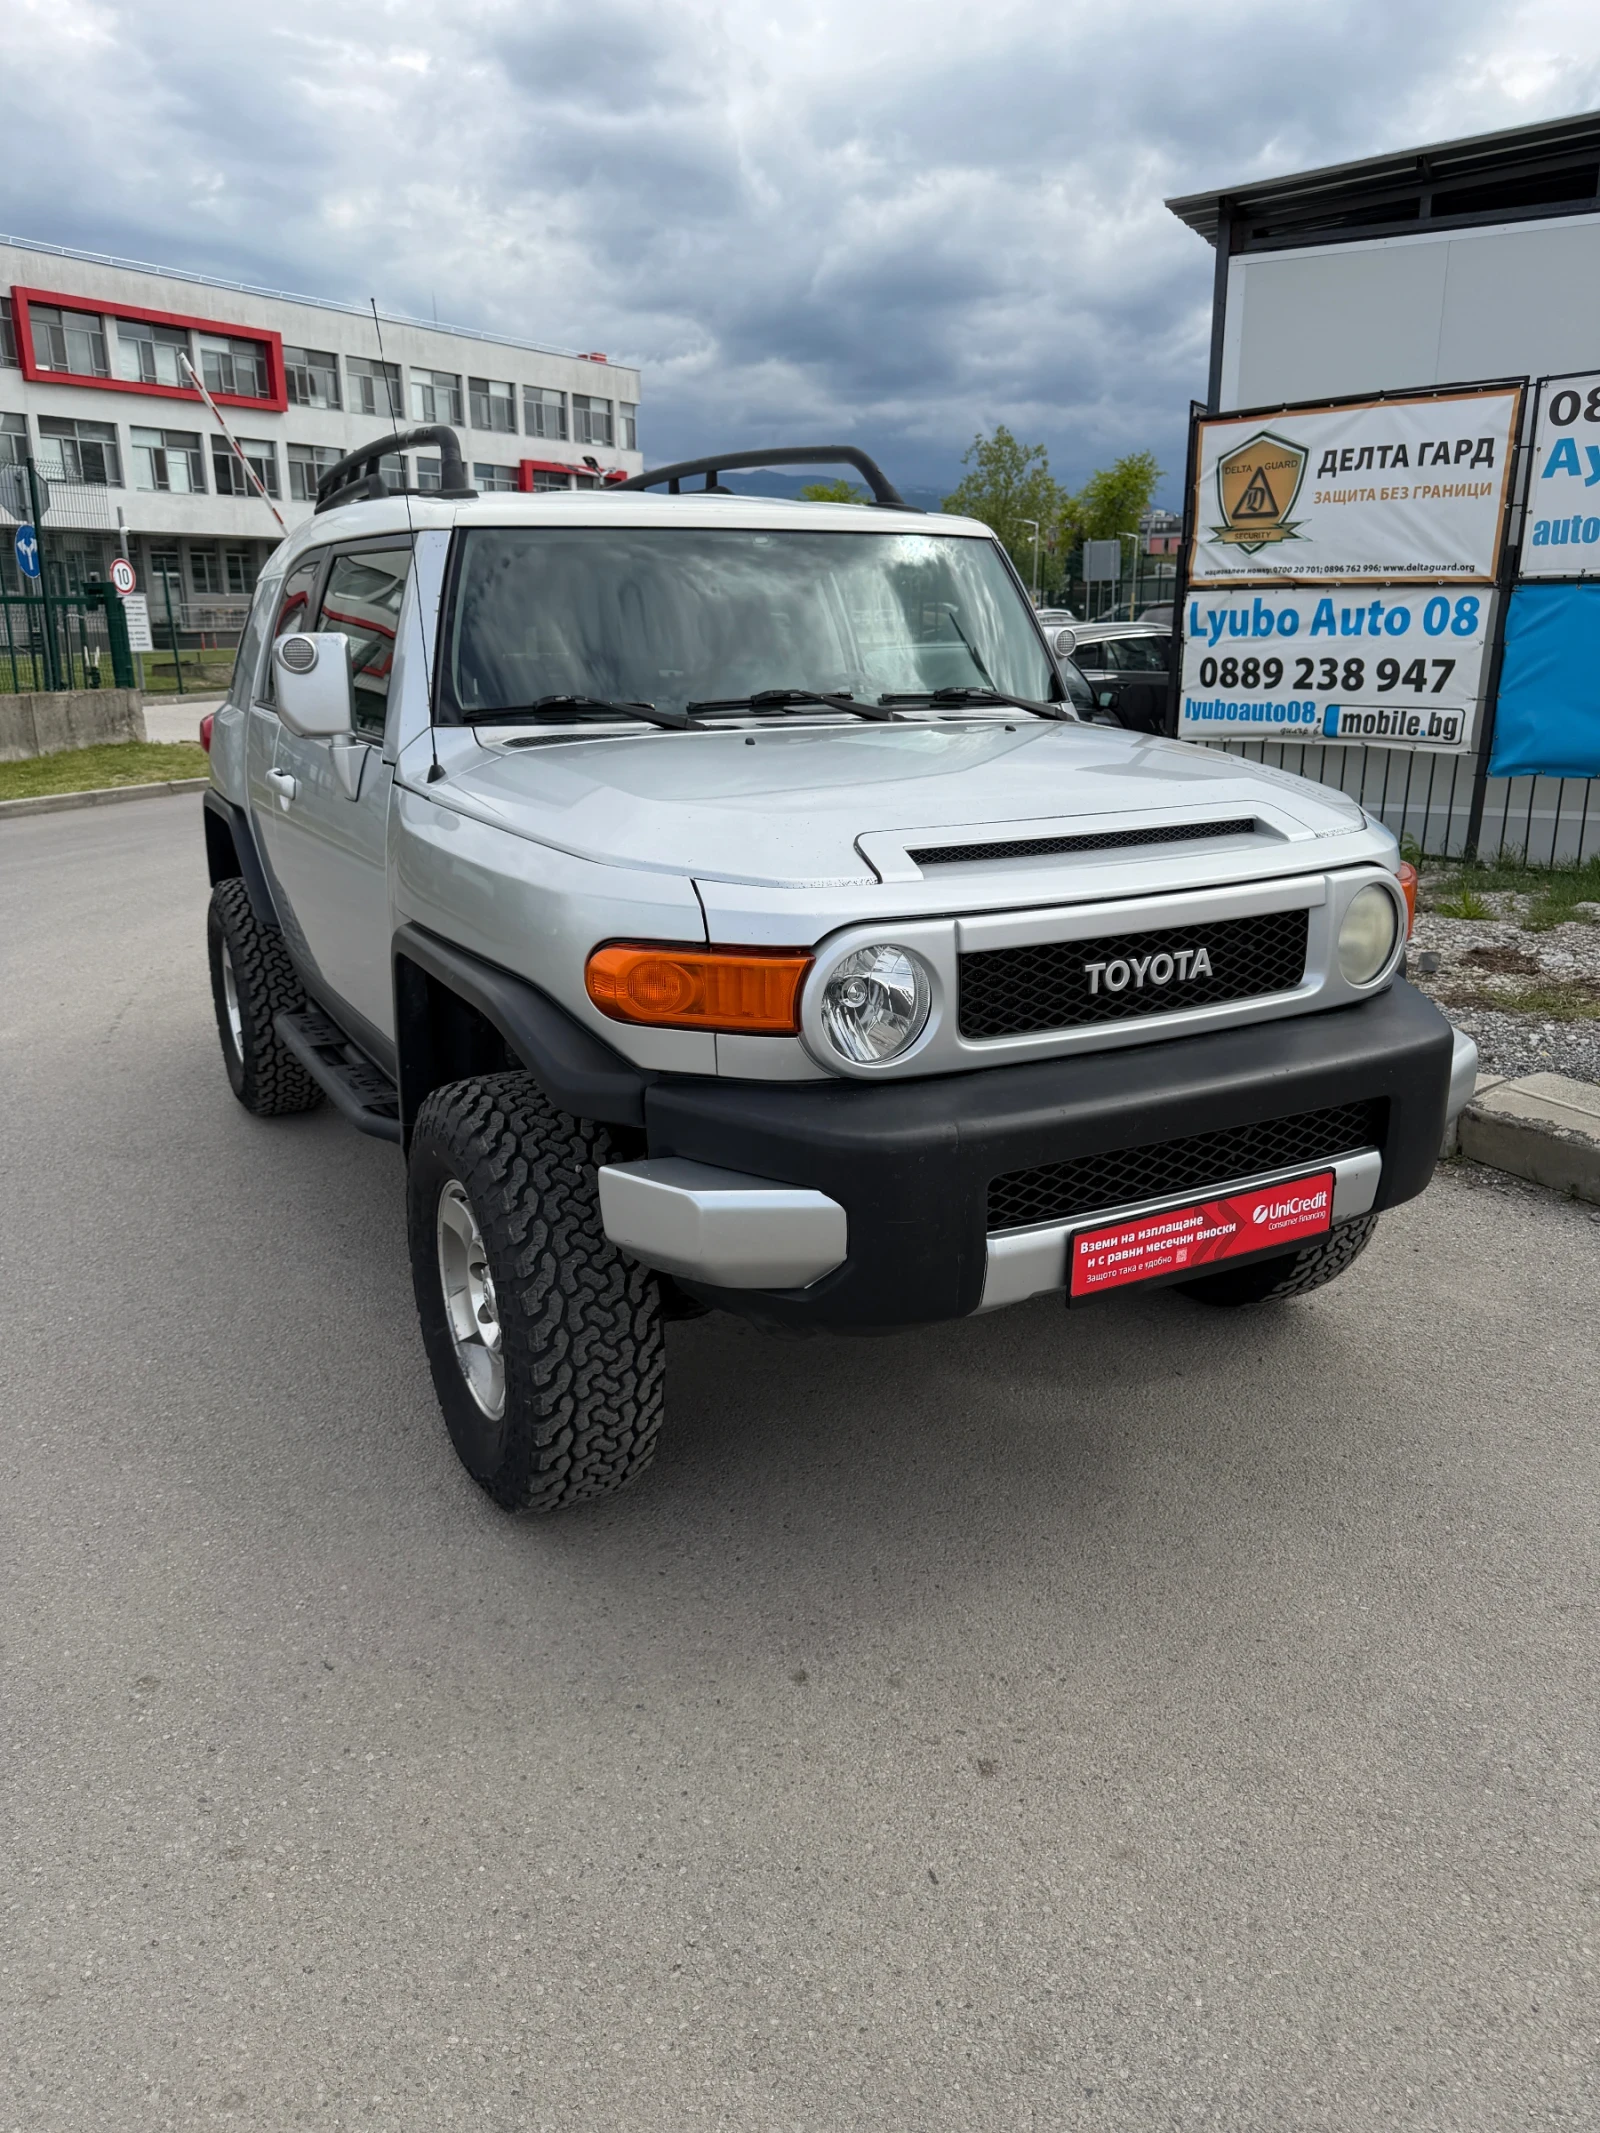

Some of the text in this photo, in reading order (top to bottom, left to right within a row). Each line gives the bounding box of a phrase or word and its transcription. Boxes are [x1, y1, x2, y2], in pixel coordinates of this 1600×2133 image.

[1225, 460, 1298, 474] DELTA GUARD
[1317, 437, 1495, 479] ДЕЛТА ГАРД
[1313, 482, 1492, 505] ЗАЩИТА БЕЗ ГРАНИЦИ
[1234, 531, 1272, 540] SECURITY
[1532, 514, 1600, 546] auto
[116, 568, 130, 585] 10
[1324, 565, 1344, 573] 0896
[1346, 564, 1361, 573] 762
[1383, 562, 1475, 573] www.deltaguard.org
[1189, 596, 1480, 648] Lyubo Auto 08
[1200, 657, 1456, 693] 0889 238 947
[1084, 948, 1213, 994] TOYOTA
[1269, 1191, 1327, 1219] UniCredit
[1080, 1216, 1204, 1254] Вземи на изплащане
[1268, 1210, 1326, 1231] Consumer Financing
[1087, 1222, 1237, 1268] и с равни месечни вноски
[1086, 1255, 1172, 1284] Защото така е удобно
